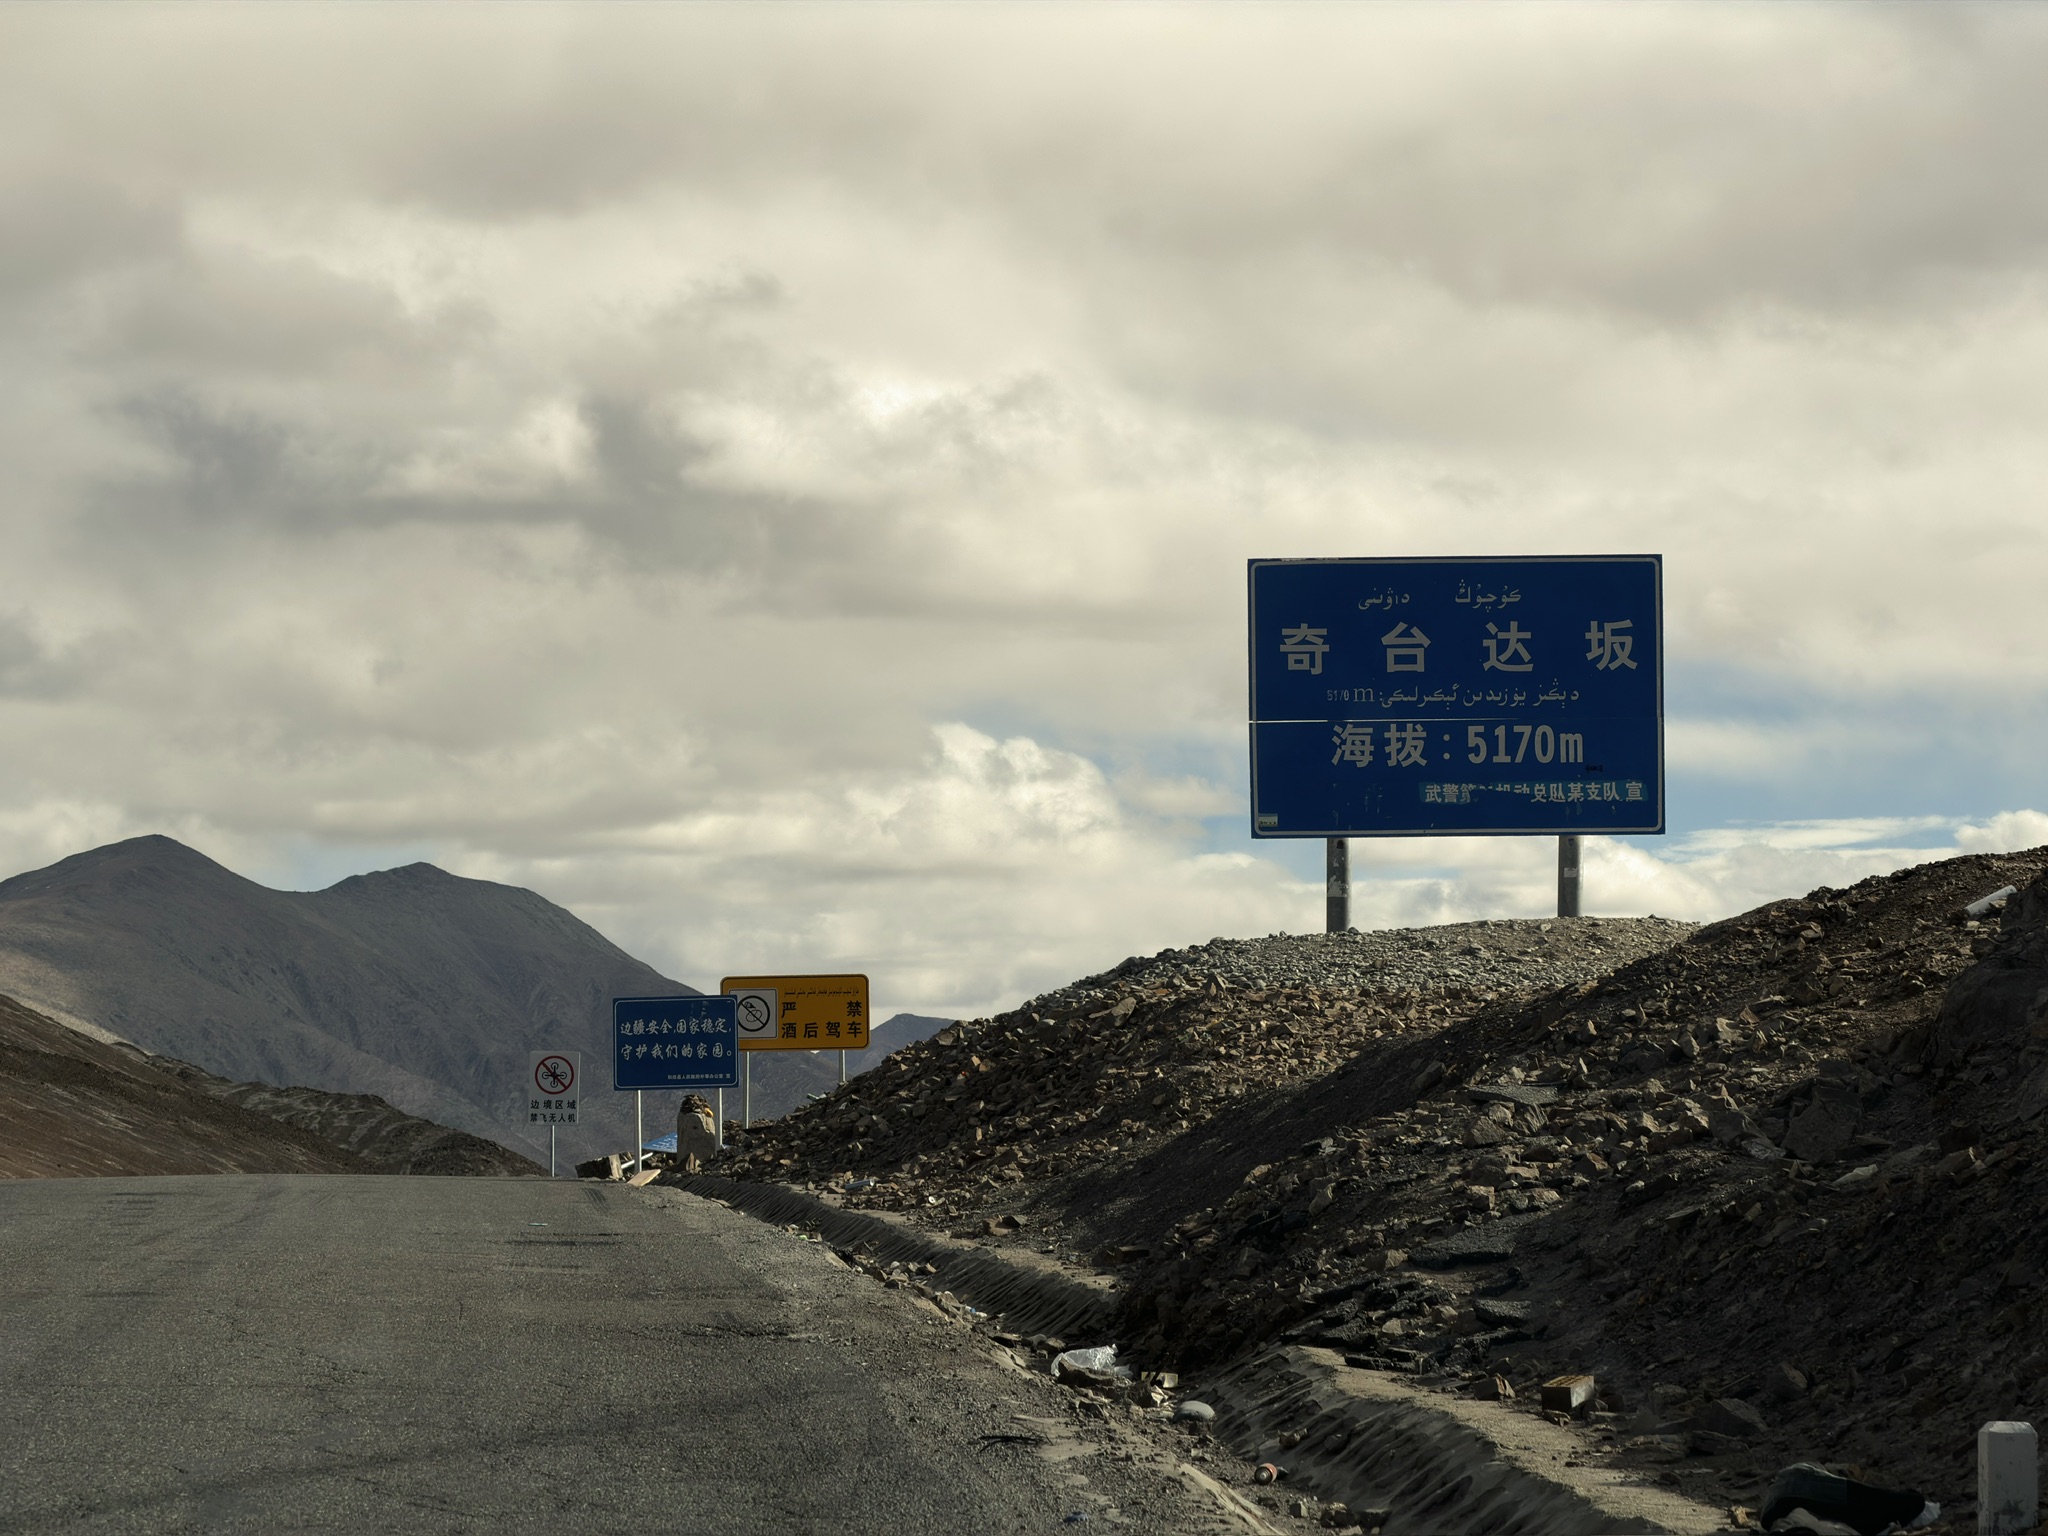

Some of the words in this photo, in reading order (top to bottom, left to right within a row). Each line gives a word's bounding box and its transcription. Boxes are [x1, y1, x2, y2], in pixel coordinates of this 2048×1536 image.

[1279, 619, 1639, 675] 奇台达坂
[781, 1001, 862, 1019] 严禁
[781, 1021, 862, 1039] 酒后驾车
[530, 1099, 577, 1110] 边境区域
[530, 1112, 576, 1124] 禁飞无人机
